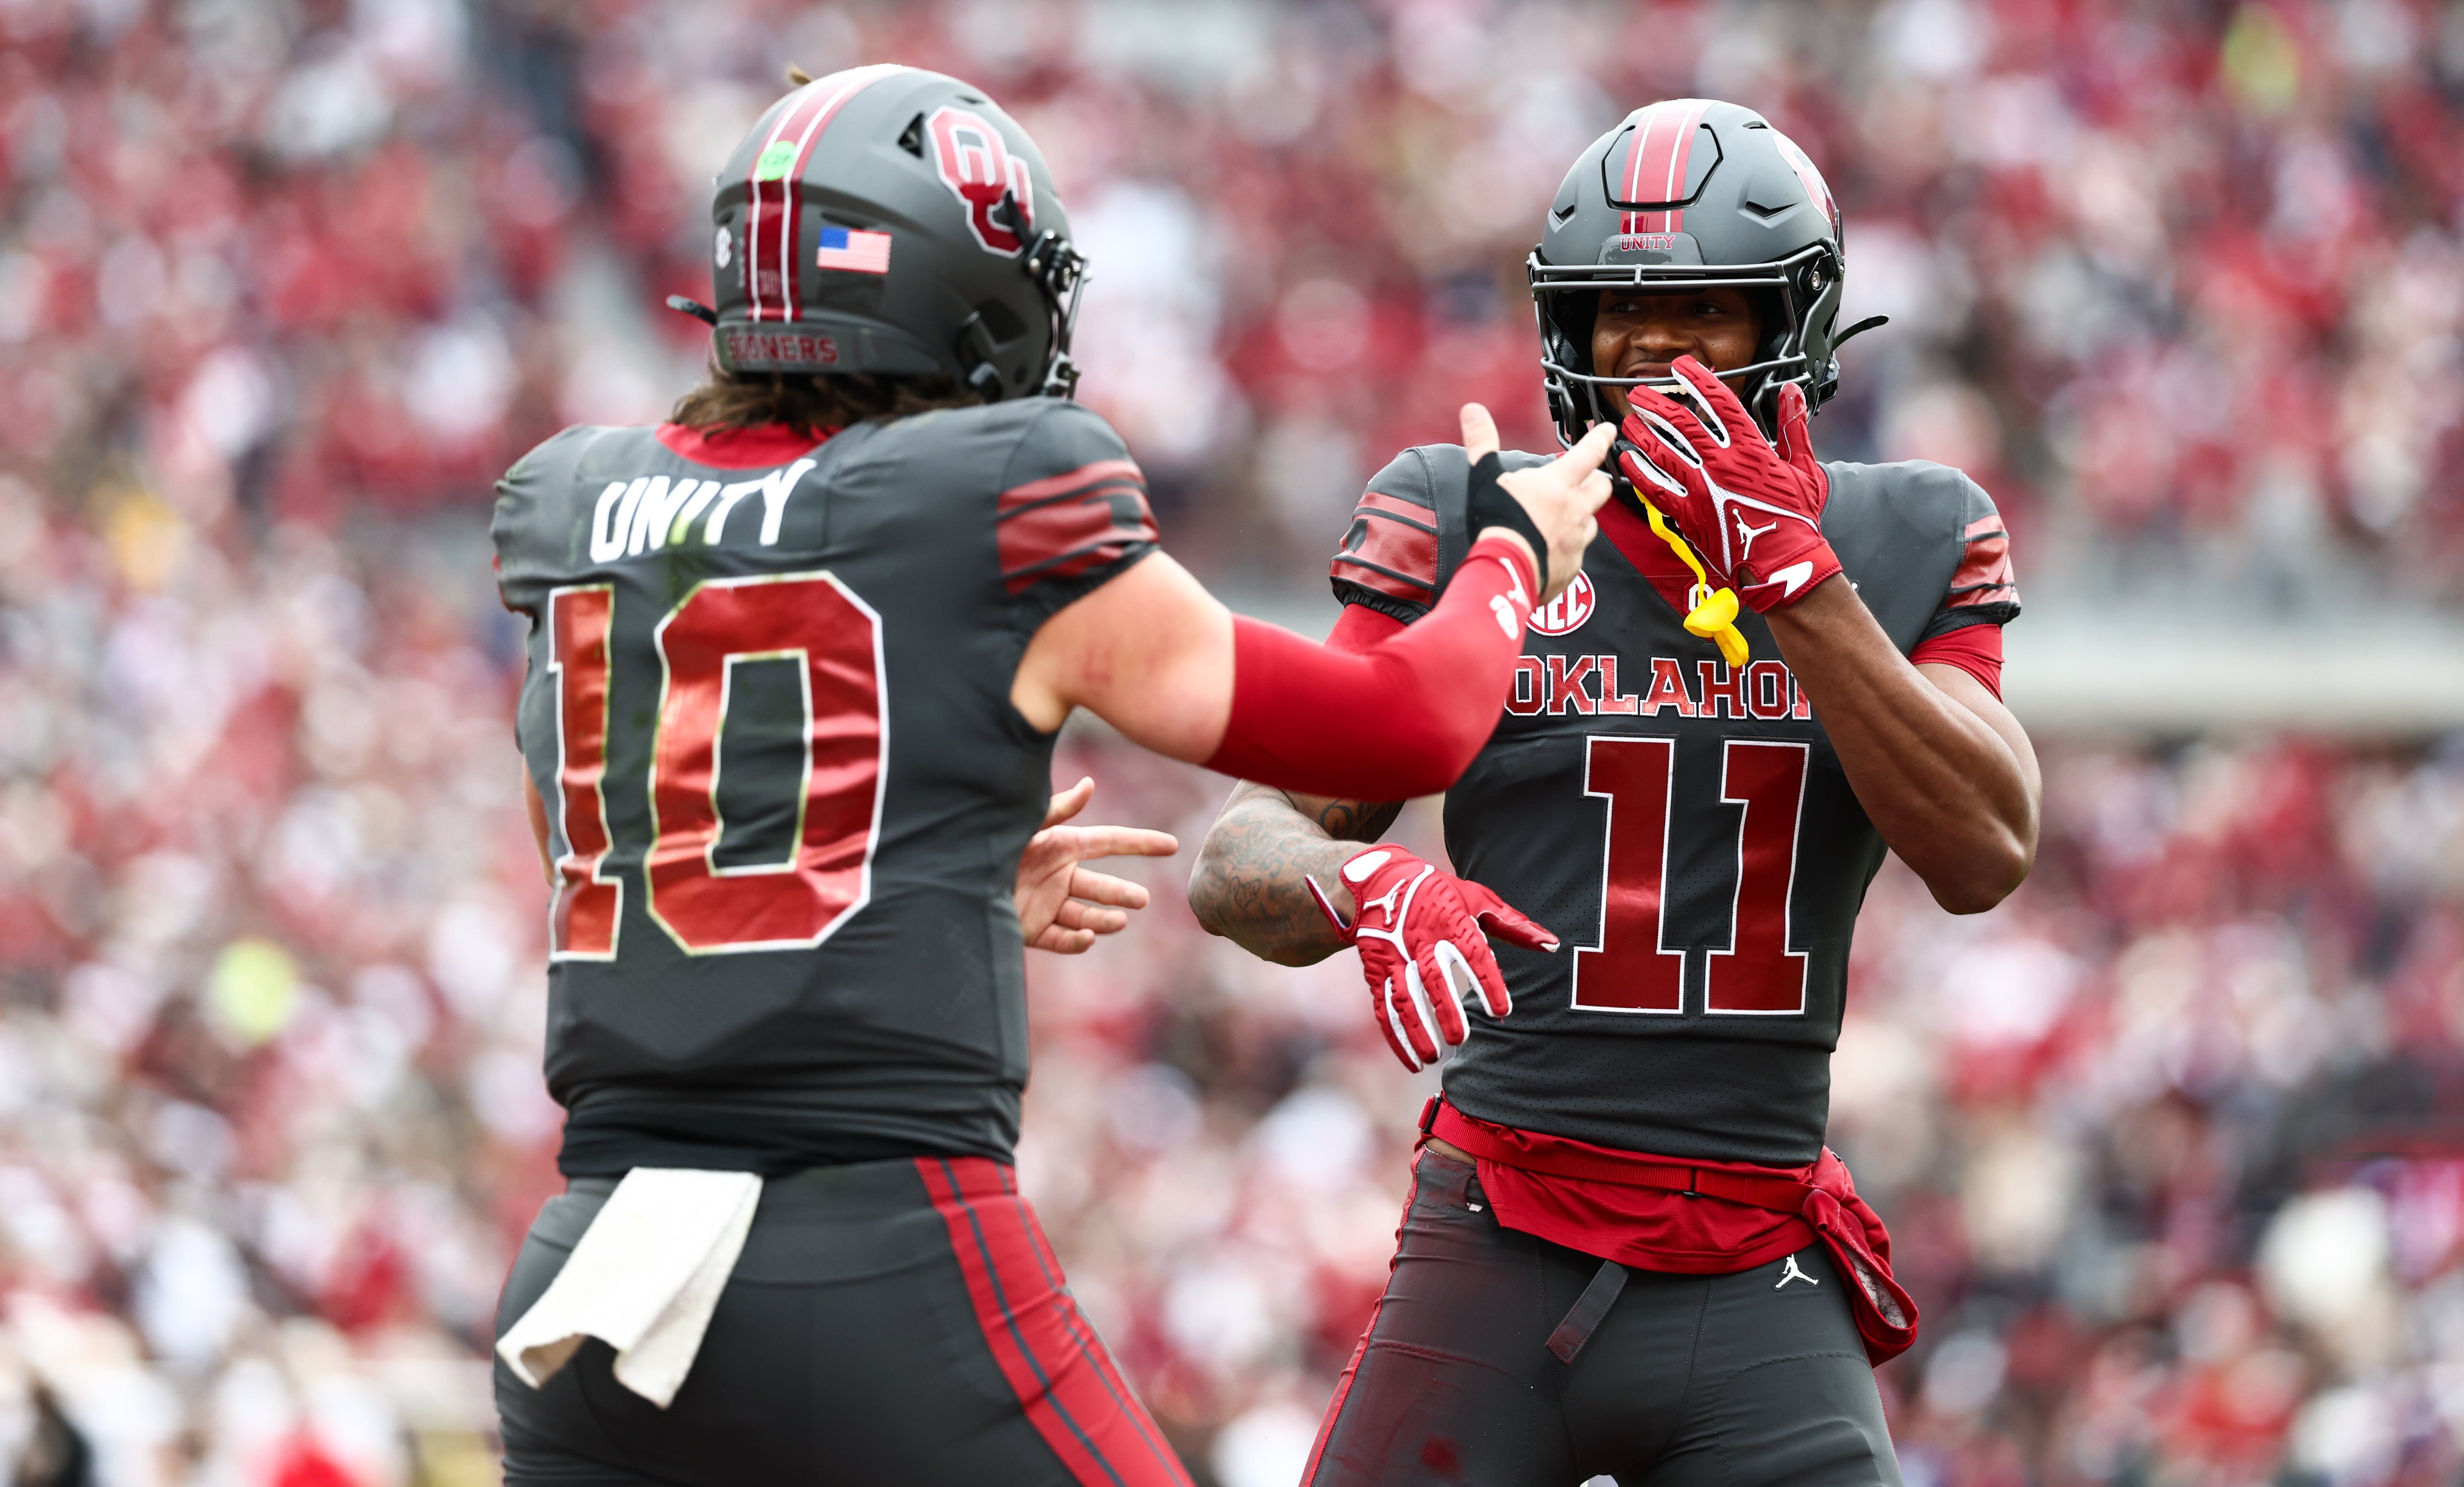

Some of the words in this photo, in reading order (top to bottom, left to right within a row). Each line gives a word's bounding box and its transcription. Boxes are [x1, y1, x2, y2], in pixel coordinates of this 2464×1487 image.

[925, 105, 1035, 258] OU
[1620, 235, 1675, 251] UNITY
[590, 459, 817, 563] UNITY
[1504, 654, 1811, 720] OKLAHO
[547, 570, 889, 962] 10
[1570, 735, 1810, 1015] 11
